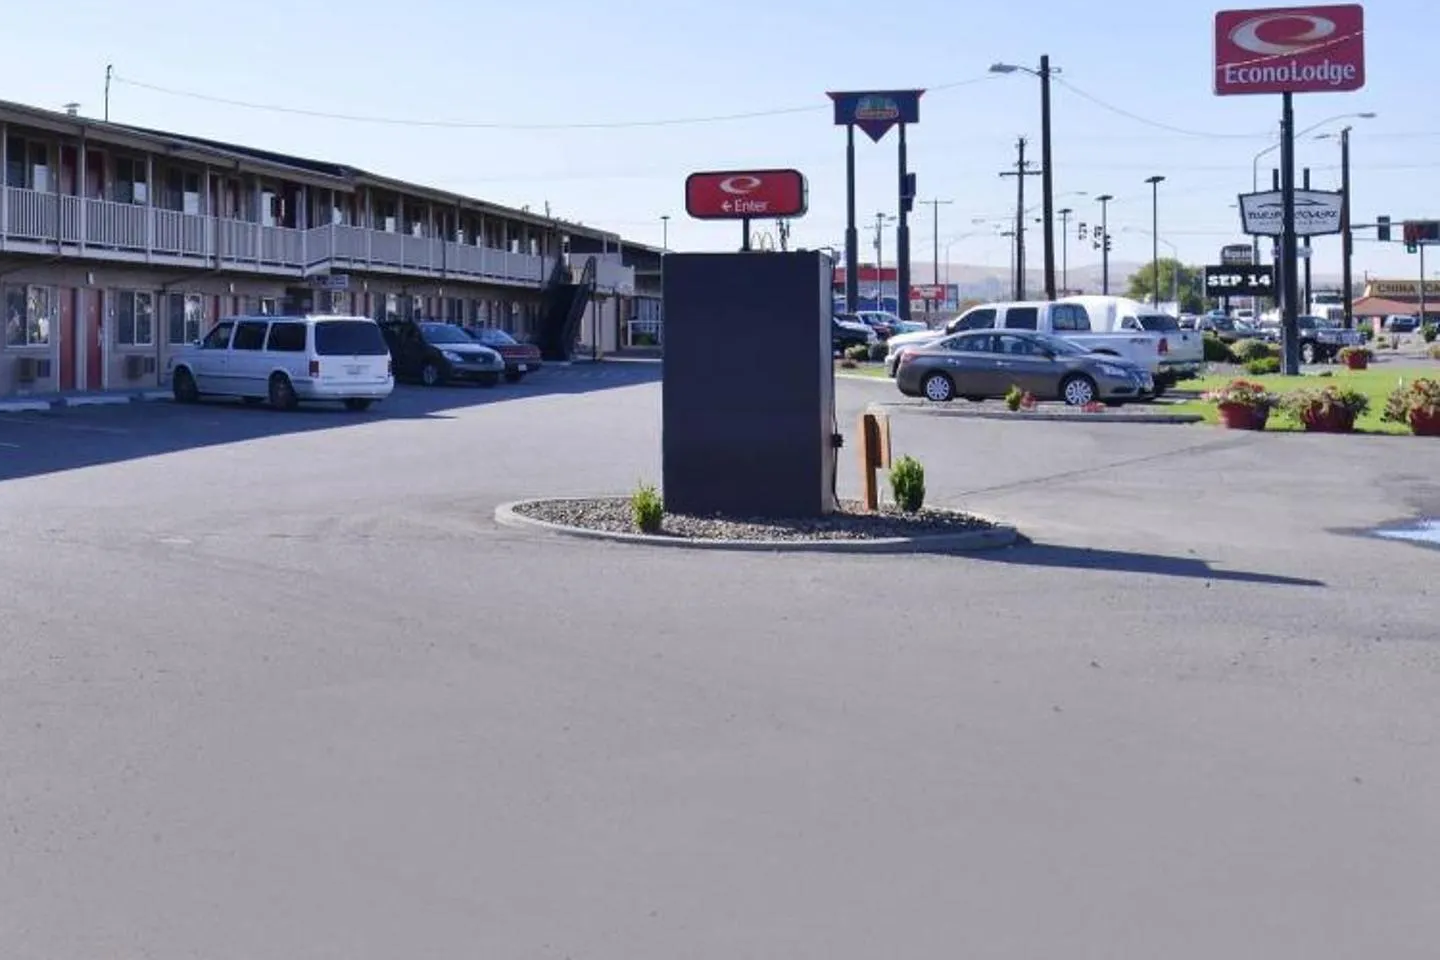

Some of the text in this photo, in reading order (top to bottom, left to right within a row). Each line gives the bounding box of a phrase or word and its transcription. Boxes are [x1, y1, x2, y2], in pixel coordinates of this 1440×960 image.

[1225, 60, 1356, 85] EconoLodge
[735, 199, 768, 213] Enter
[1207, 274, 1271, 287] SEP 14
[1378, 283, 1417, 293] CHINA
